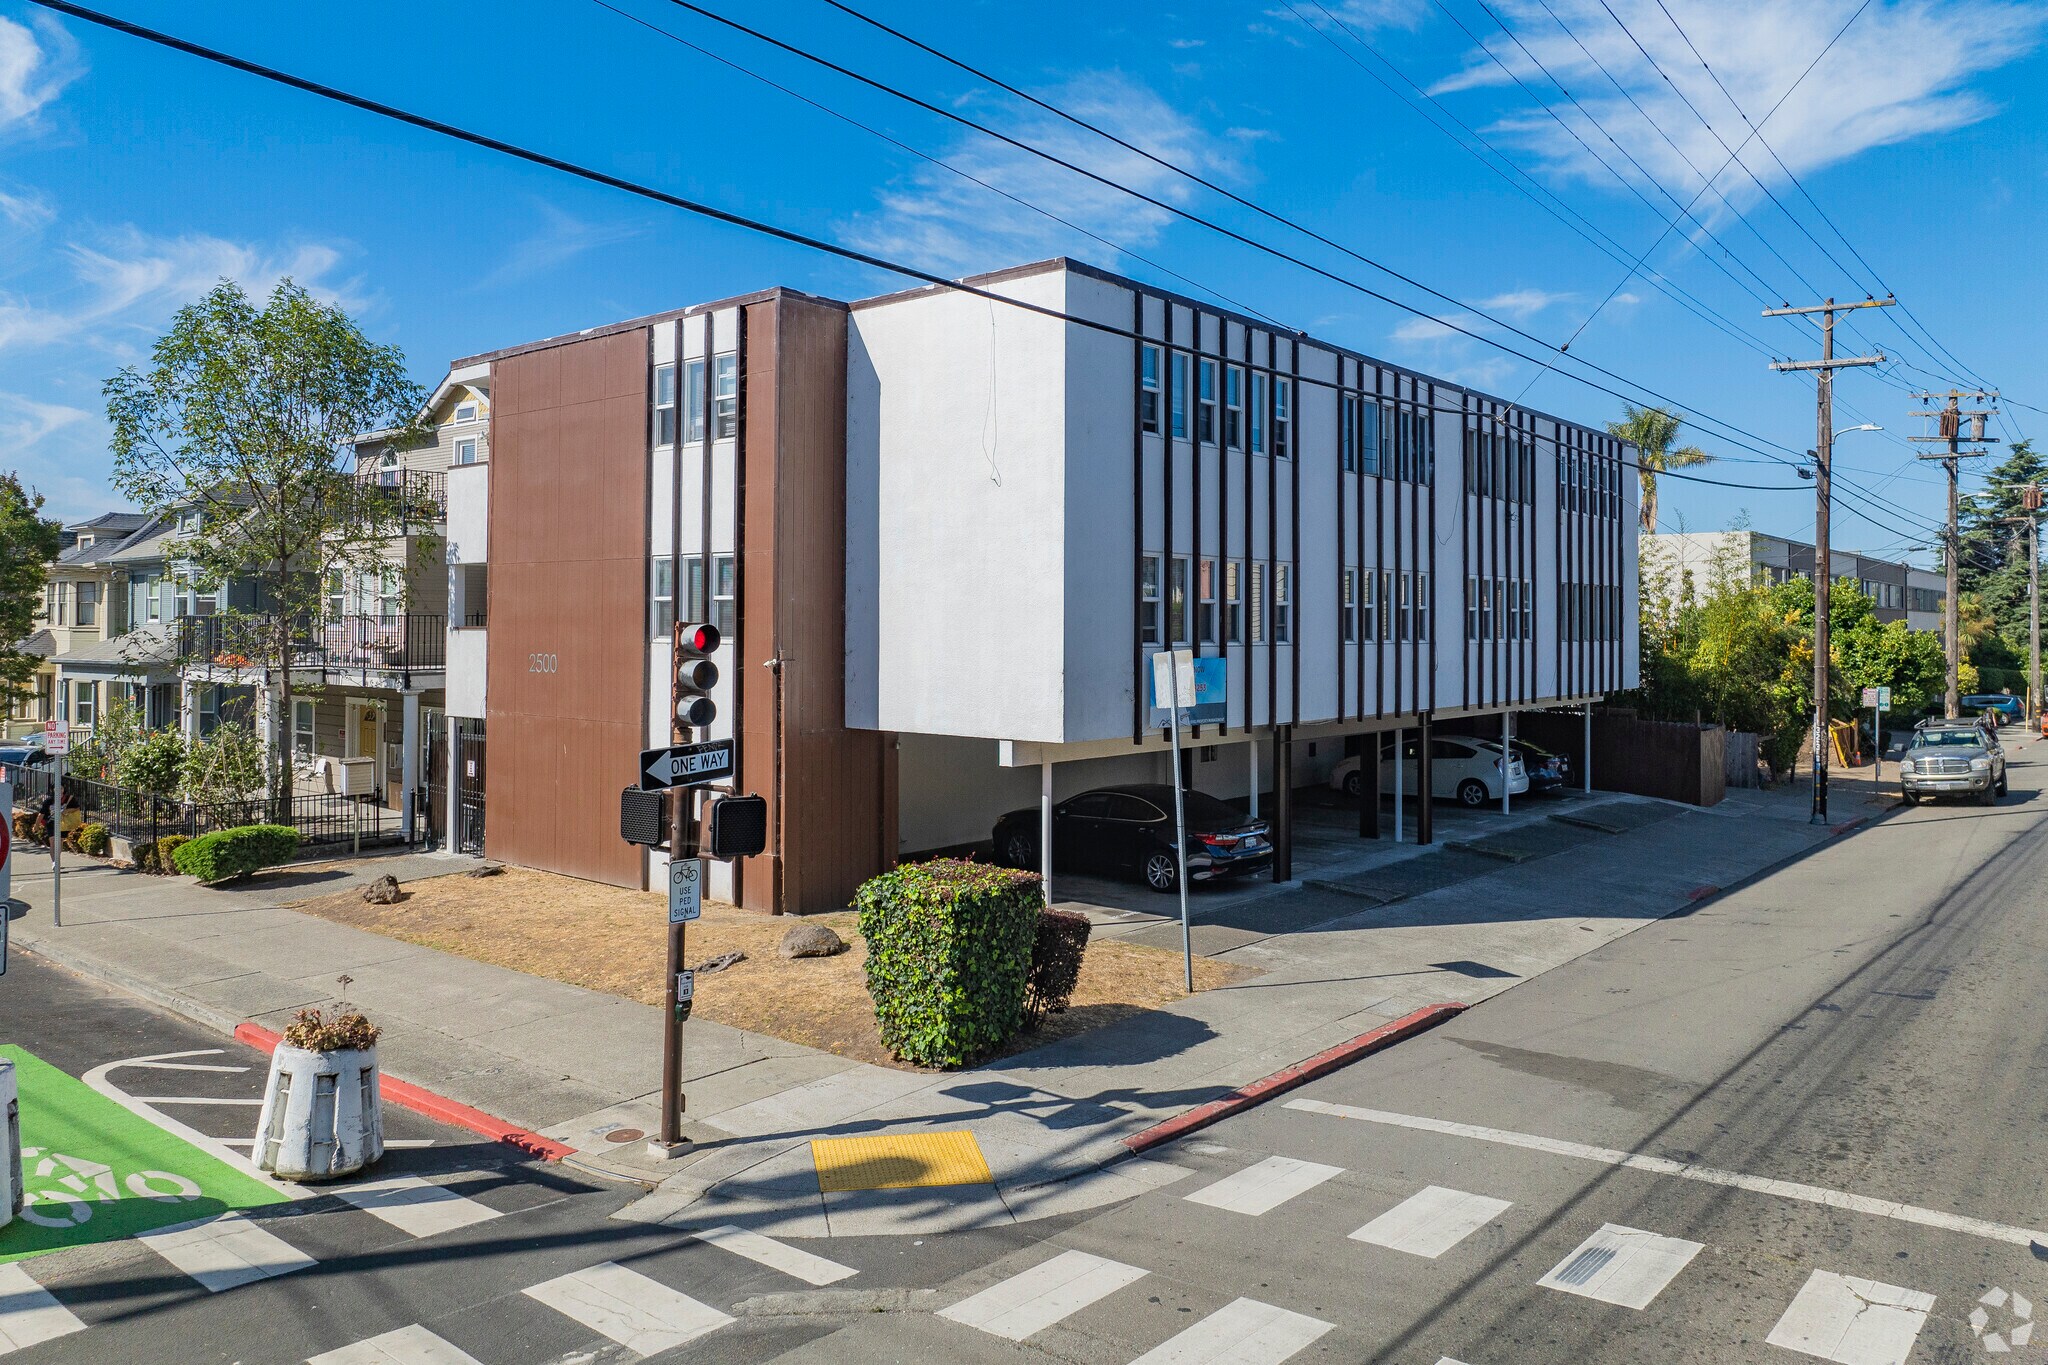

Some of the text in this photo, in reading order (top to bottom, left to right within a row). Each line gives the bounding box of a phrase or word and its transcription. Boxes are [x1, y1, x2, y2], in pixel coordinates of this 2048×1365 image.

[529, 653, 557, 673] 2500
[47, 722, 56, 730] NO
[671, 752, 725, 774] ONE WAY
[680, 886, 691, 895] USE
[680, 896, 691, 905] PED
[674, 906, 696, 917] SIGNAL
